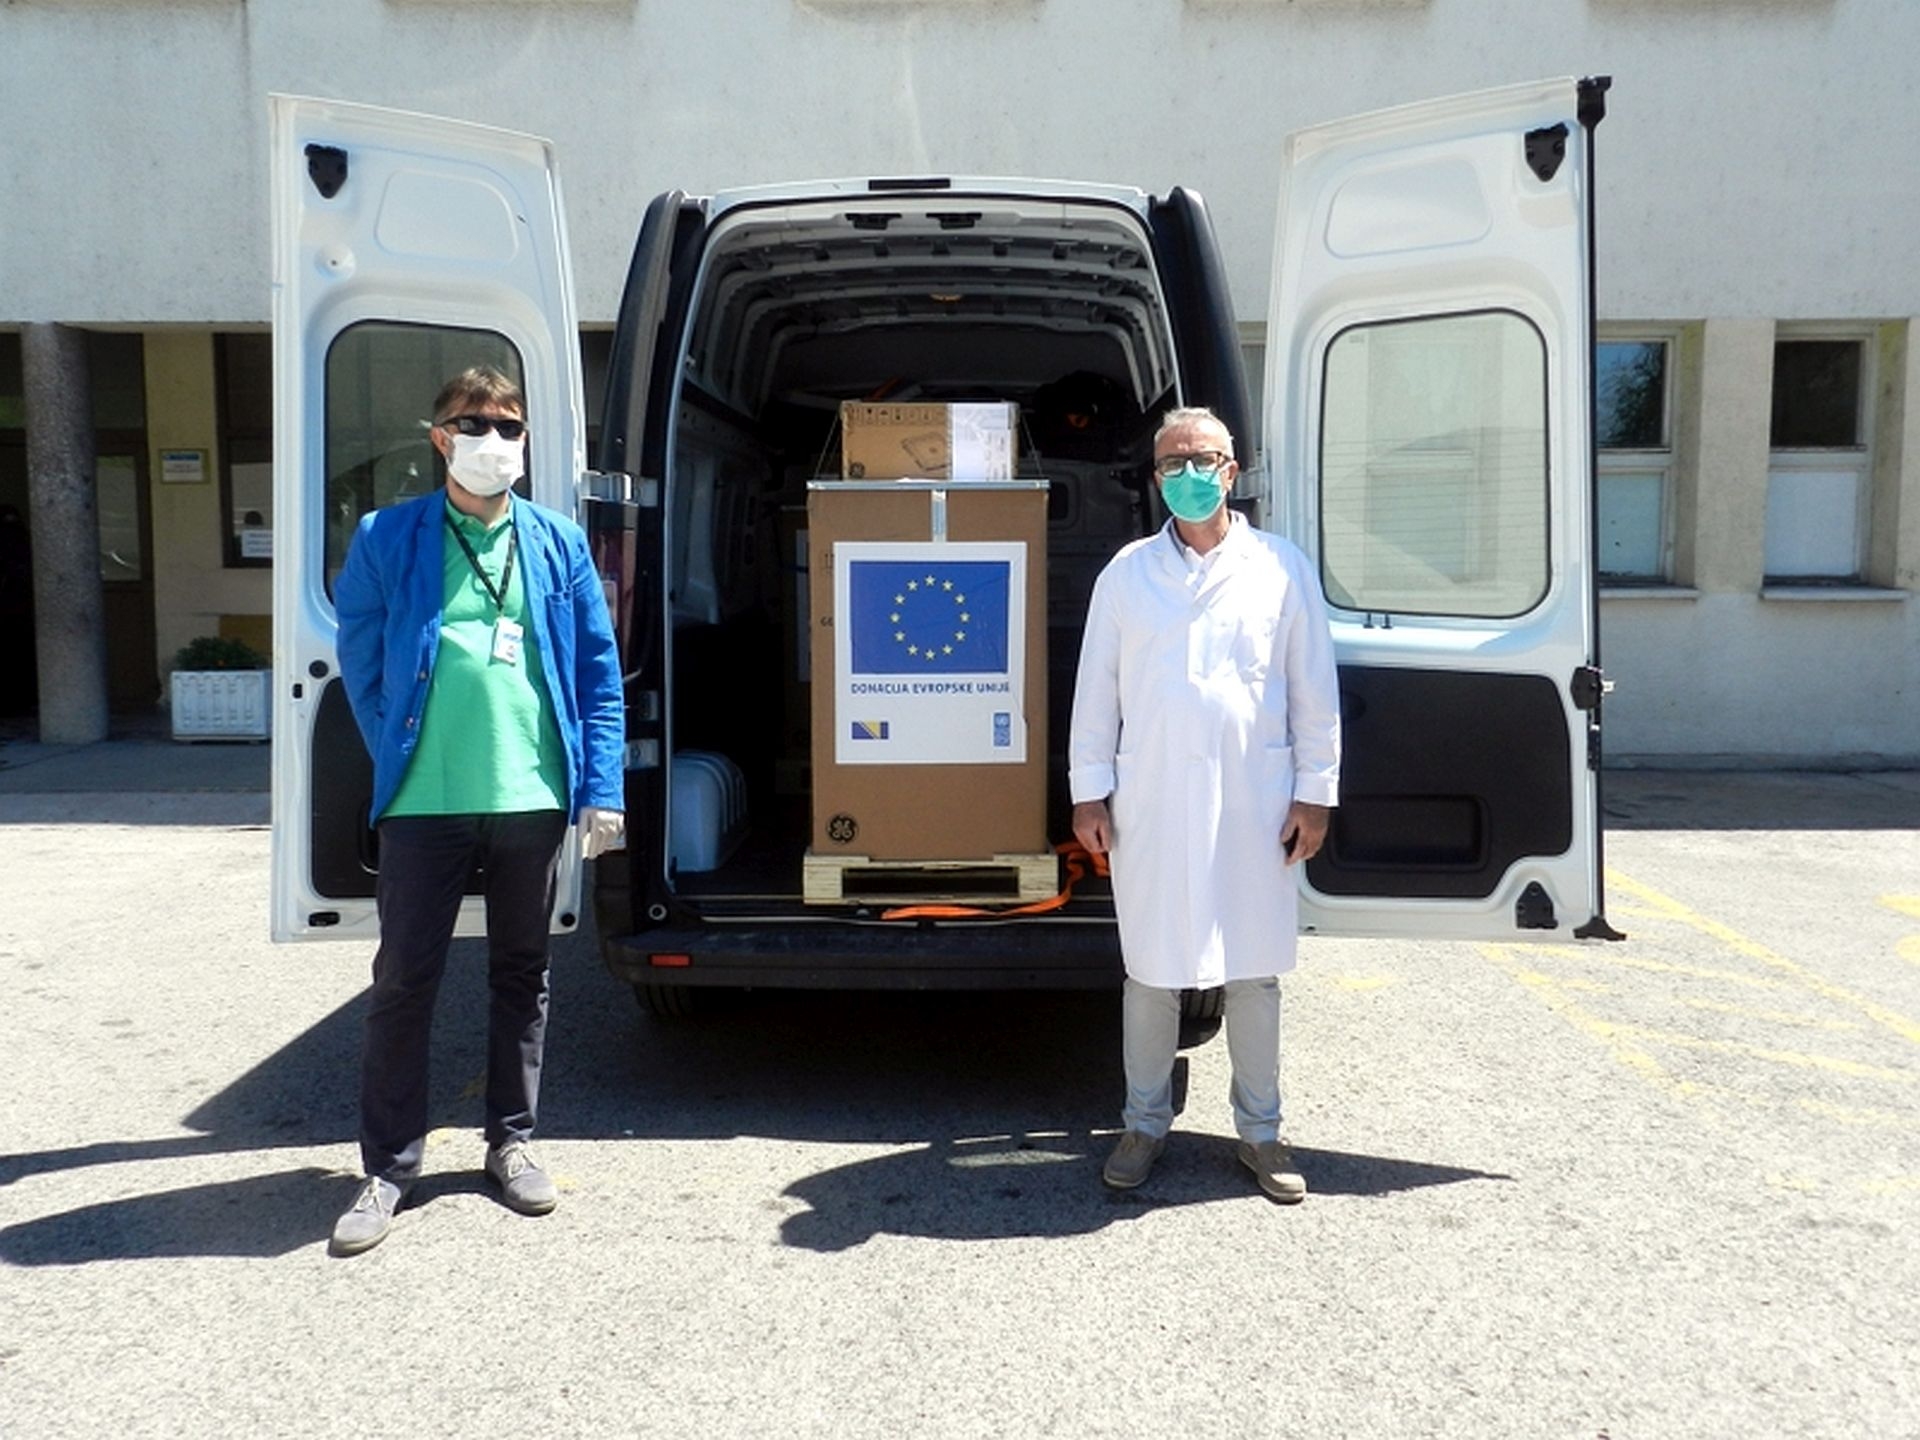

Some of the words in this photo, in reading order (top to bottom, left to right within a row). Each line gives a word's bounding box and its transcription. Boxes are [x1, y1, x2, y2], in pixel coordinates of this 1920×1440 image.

[851, 682, 909, 694] DONACIJA
[913, 682, 973, 694] EVROPSKE
[976, 682, 1009, 694] UNIJE
